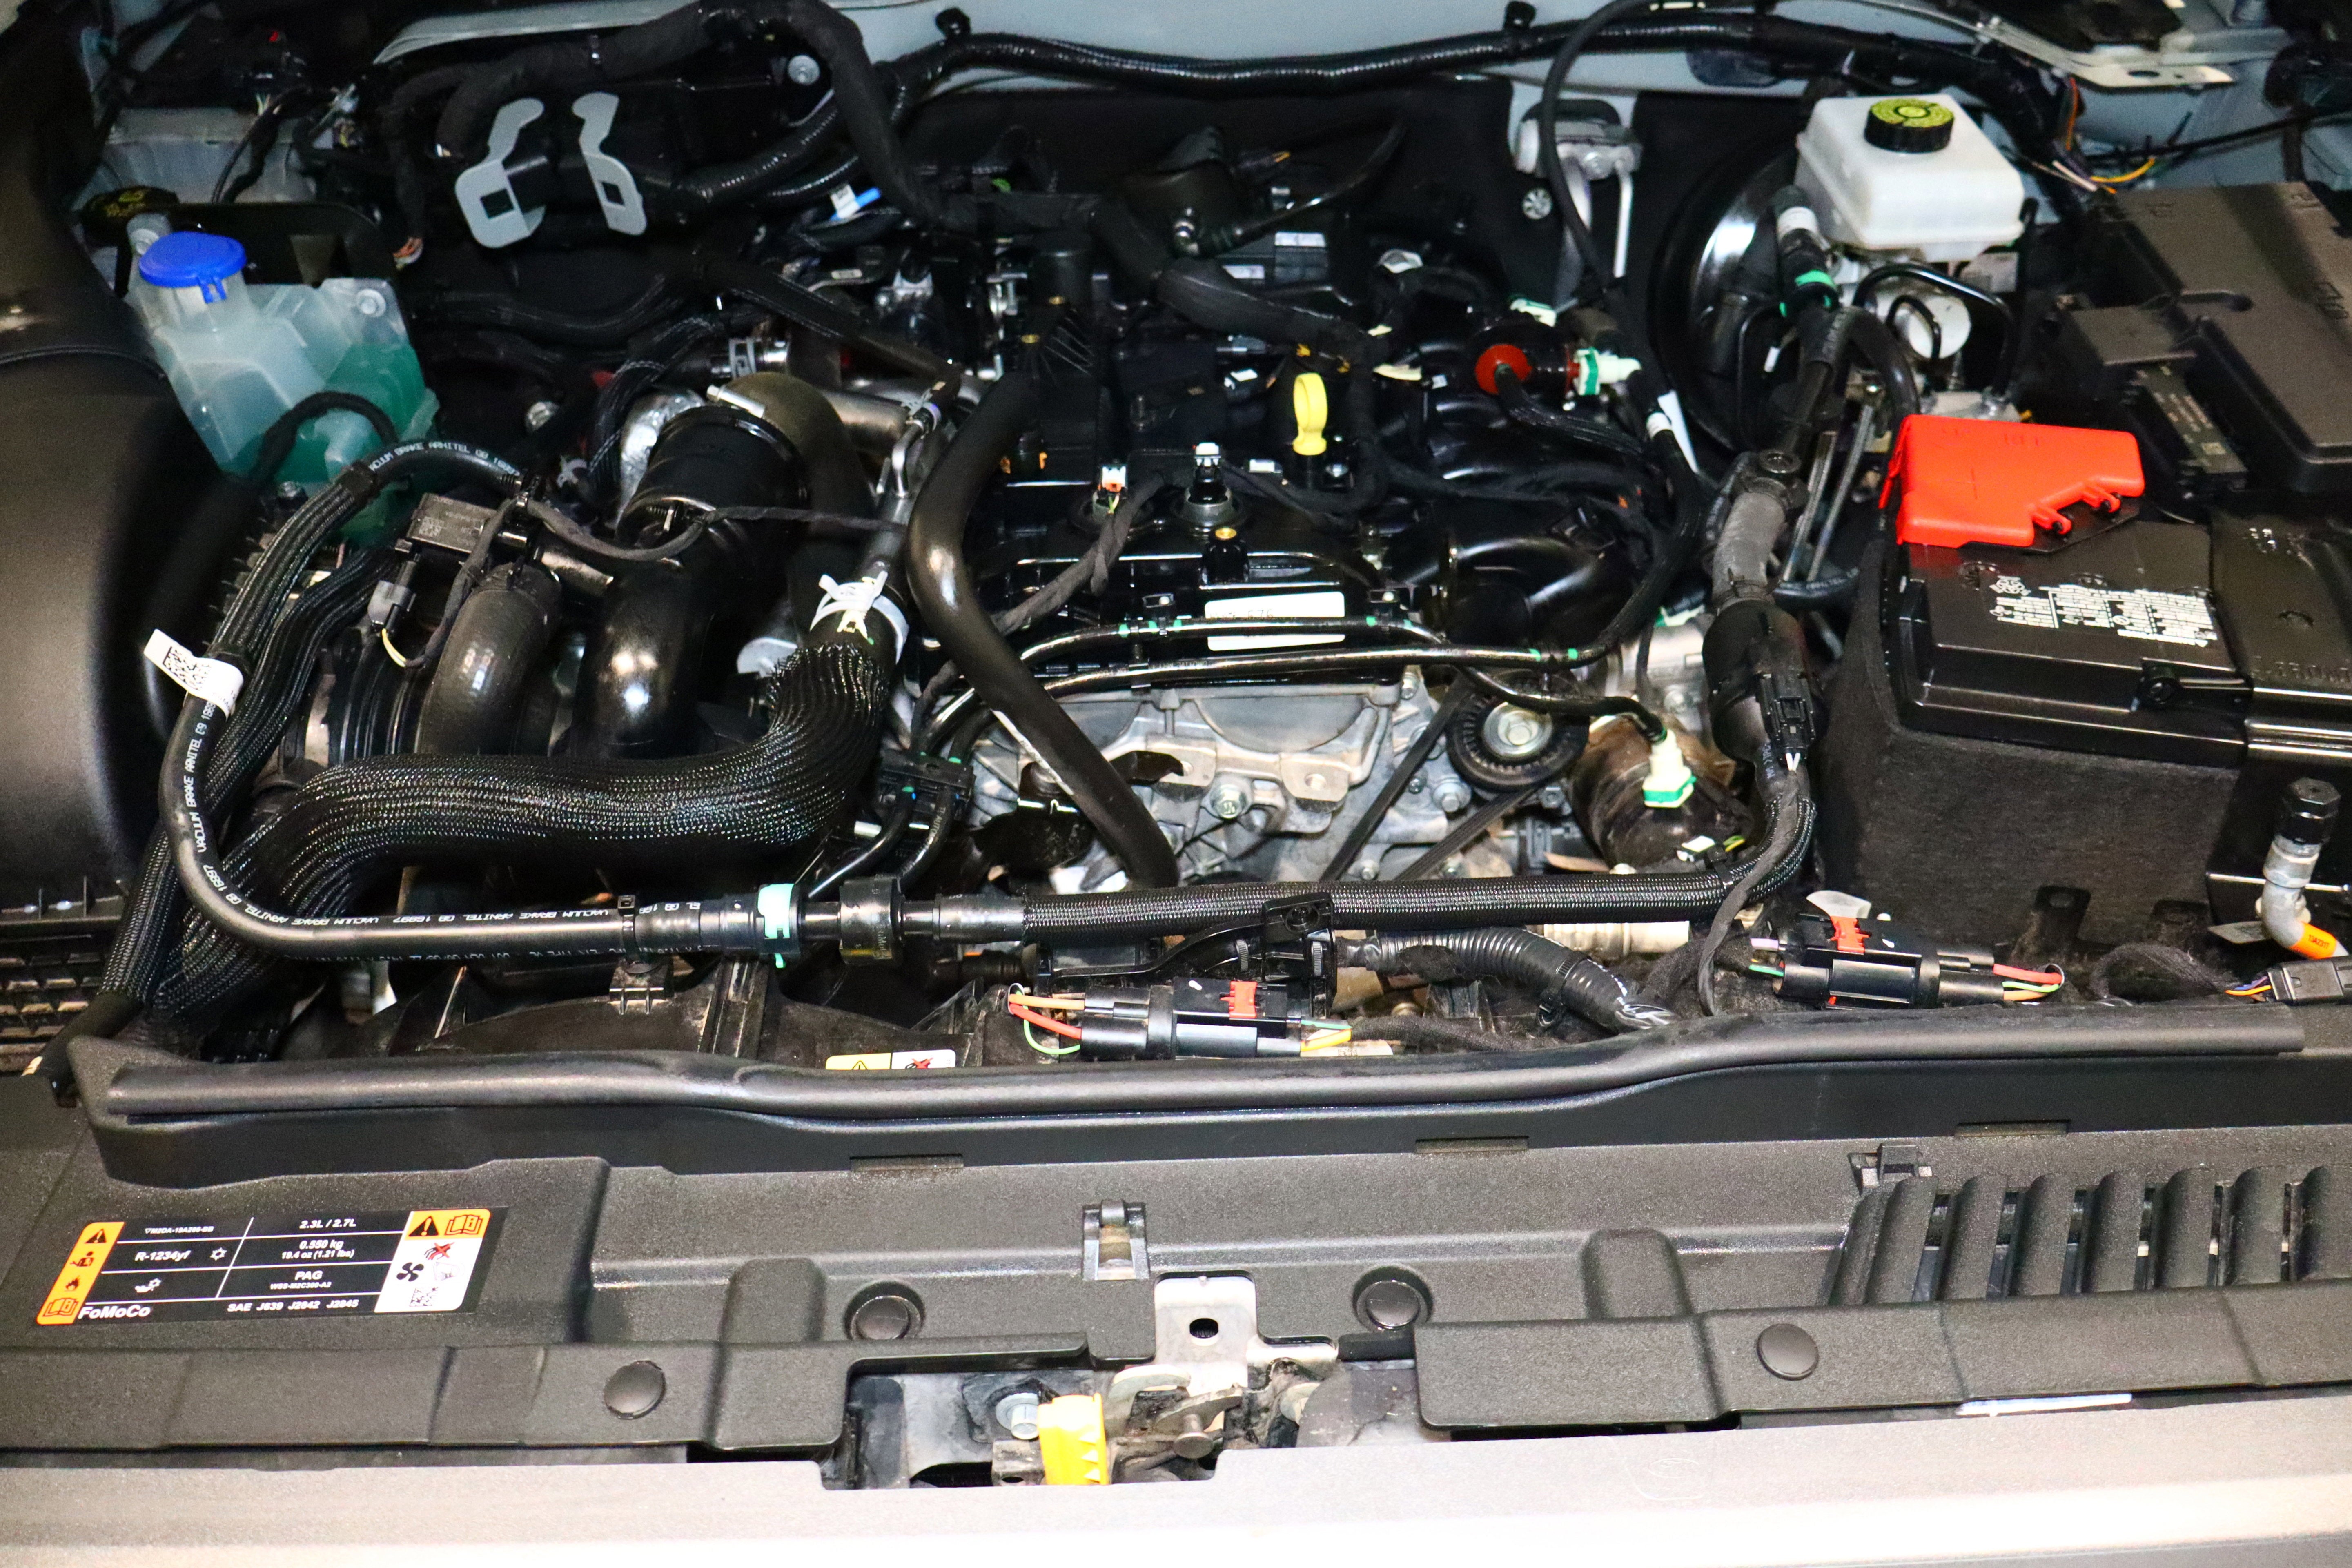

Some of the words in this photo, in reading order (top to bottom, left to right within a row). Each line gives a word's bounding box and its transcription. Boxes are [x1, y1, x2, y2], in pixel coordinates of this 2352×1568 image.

[184, 738, 203, 773] ARNITEL
[183, 775, 197, 808] BRAKE
[189, 811, 207, 853] VACUUM
[244, 903, 289, 924] ARNITEL
[463, 912, 514, 921] ARNITEL
[519, 911, 557, 920] BRAKE
[562, 909, 609, 918] VACUUM
[291, 918, 329, 926] BRAKE
[333, 916, 379, 925] VACUUM
[299, 1219, 324, 1229] 2.3L
[325, 1219, 333, 1228] /
[332, 1218, 357, 1228] 2.7L
[299, 1239, 328, 1250] 0.550
[329, 1239, 344, 1250] kg
[134, 1250, 192, 1261] R-1234yf
[282, 1250, 301, 1259] 19.4
[313, 1249, 336, 1260] (1.21
[336, 1249, 355, 1259] lbs)
[294, 1270, 323, 1281] PAG
[227, 1303, 253, 1312] SAE
[256, 1302, 284, 1311] J639
[287, 1300, 321, 1310] J2842
[326, 1299, 360, 1309] J2845
[78, 1304, 151, 1319] FoMoCo
